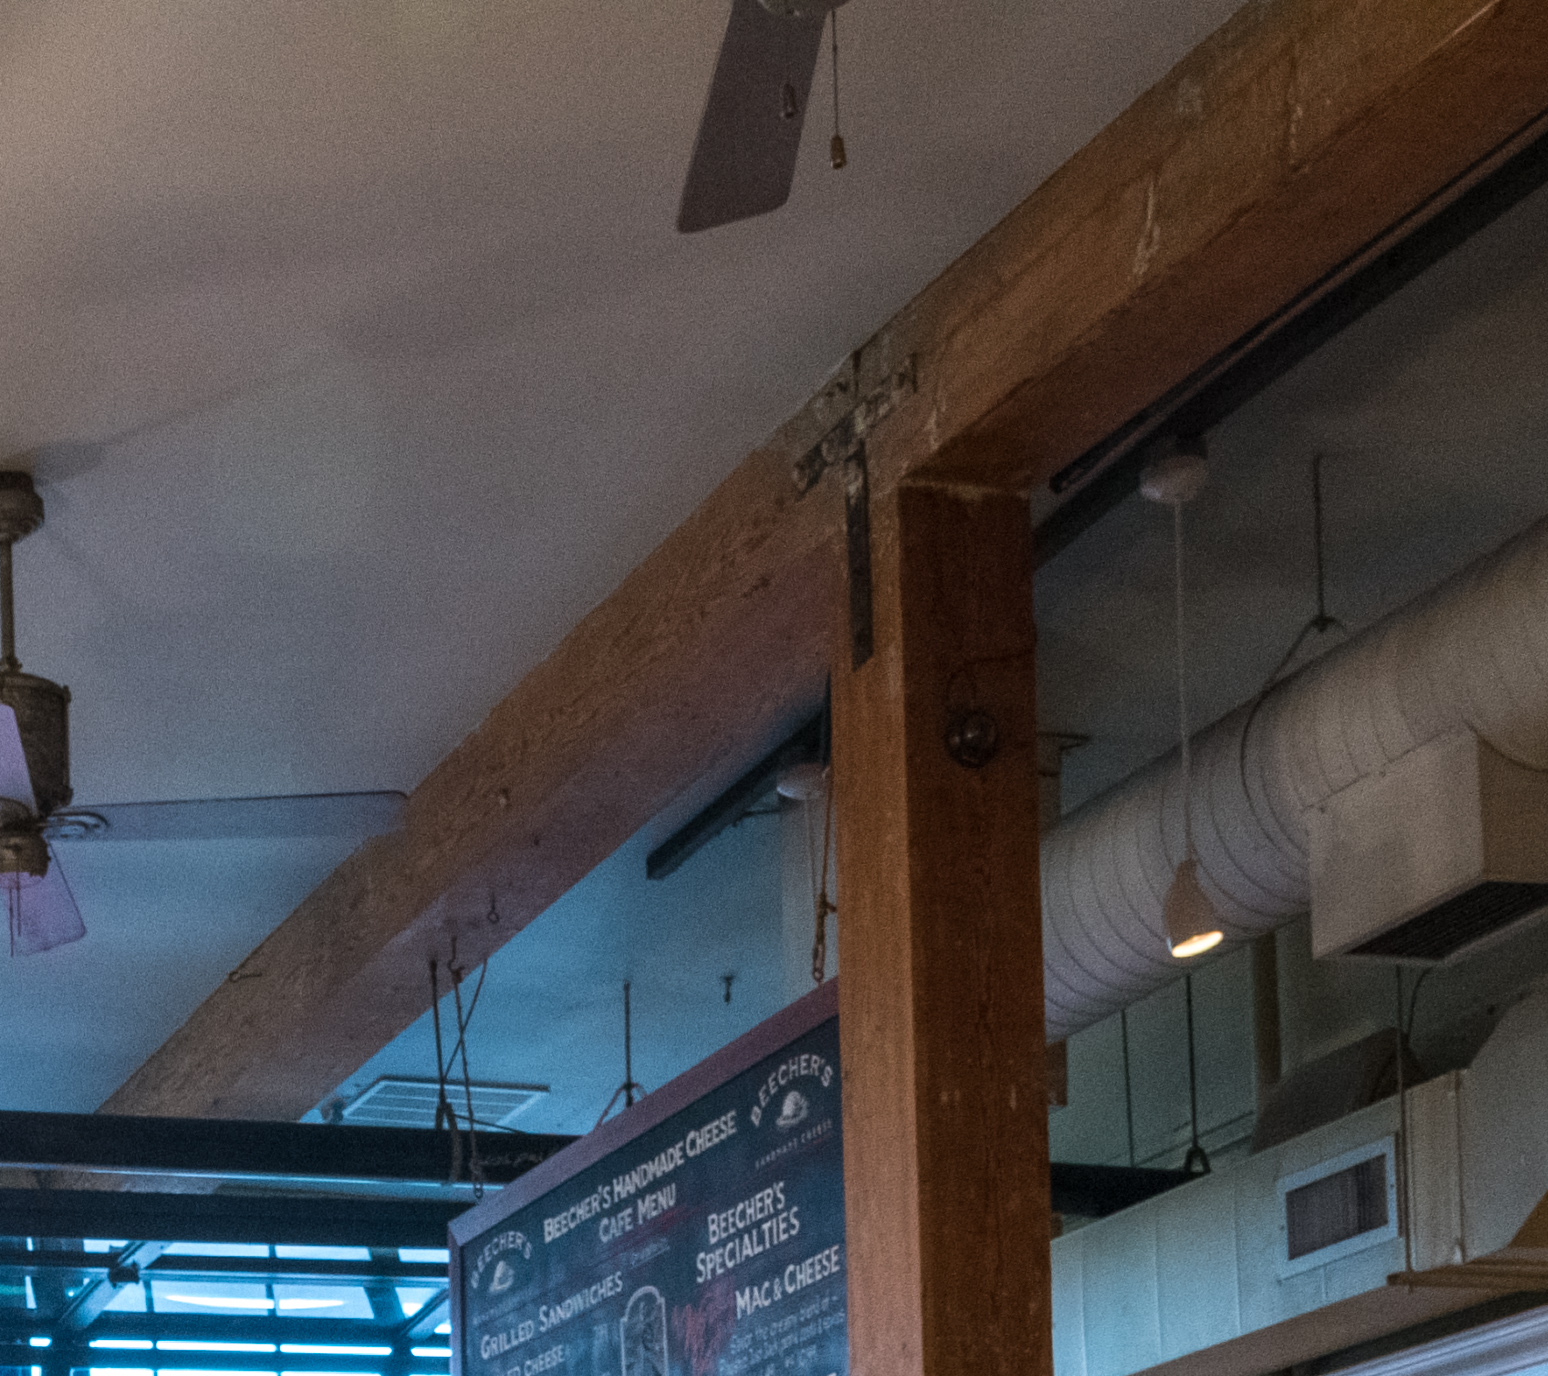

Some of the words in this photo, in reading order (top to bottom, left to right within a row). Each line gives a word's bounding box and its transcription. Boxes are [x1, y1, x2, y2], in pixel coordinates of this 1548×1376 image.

[751, 1054, 833, 1126] BEECHER'S
[543, 1185, 611, 1244] BEECHER'S
[613, 1142, 685, 1203] HANDMADE
[685, 1110, 738, 1157] CHEESE
[599, 1207, 634, 1243] CAFE
[637, 1183, 677, 1225] MENU
[707, 1181, 786, 1245] BEECHER'S
[696, 1206, 800, 1284] SPECIALTIES
[735, 1281, 771, 1320] MAC
[773, 1278, 782, 1301] &
[784, 1245, 841, 1294] CHEESE
[481, 1319, 535, 1360] GRILLED
[539, 1271, 623, 1333] SANDWICHES
